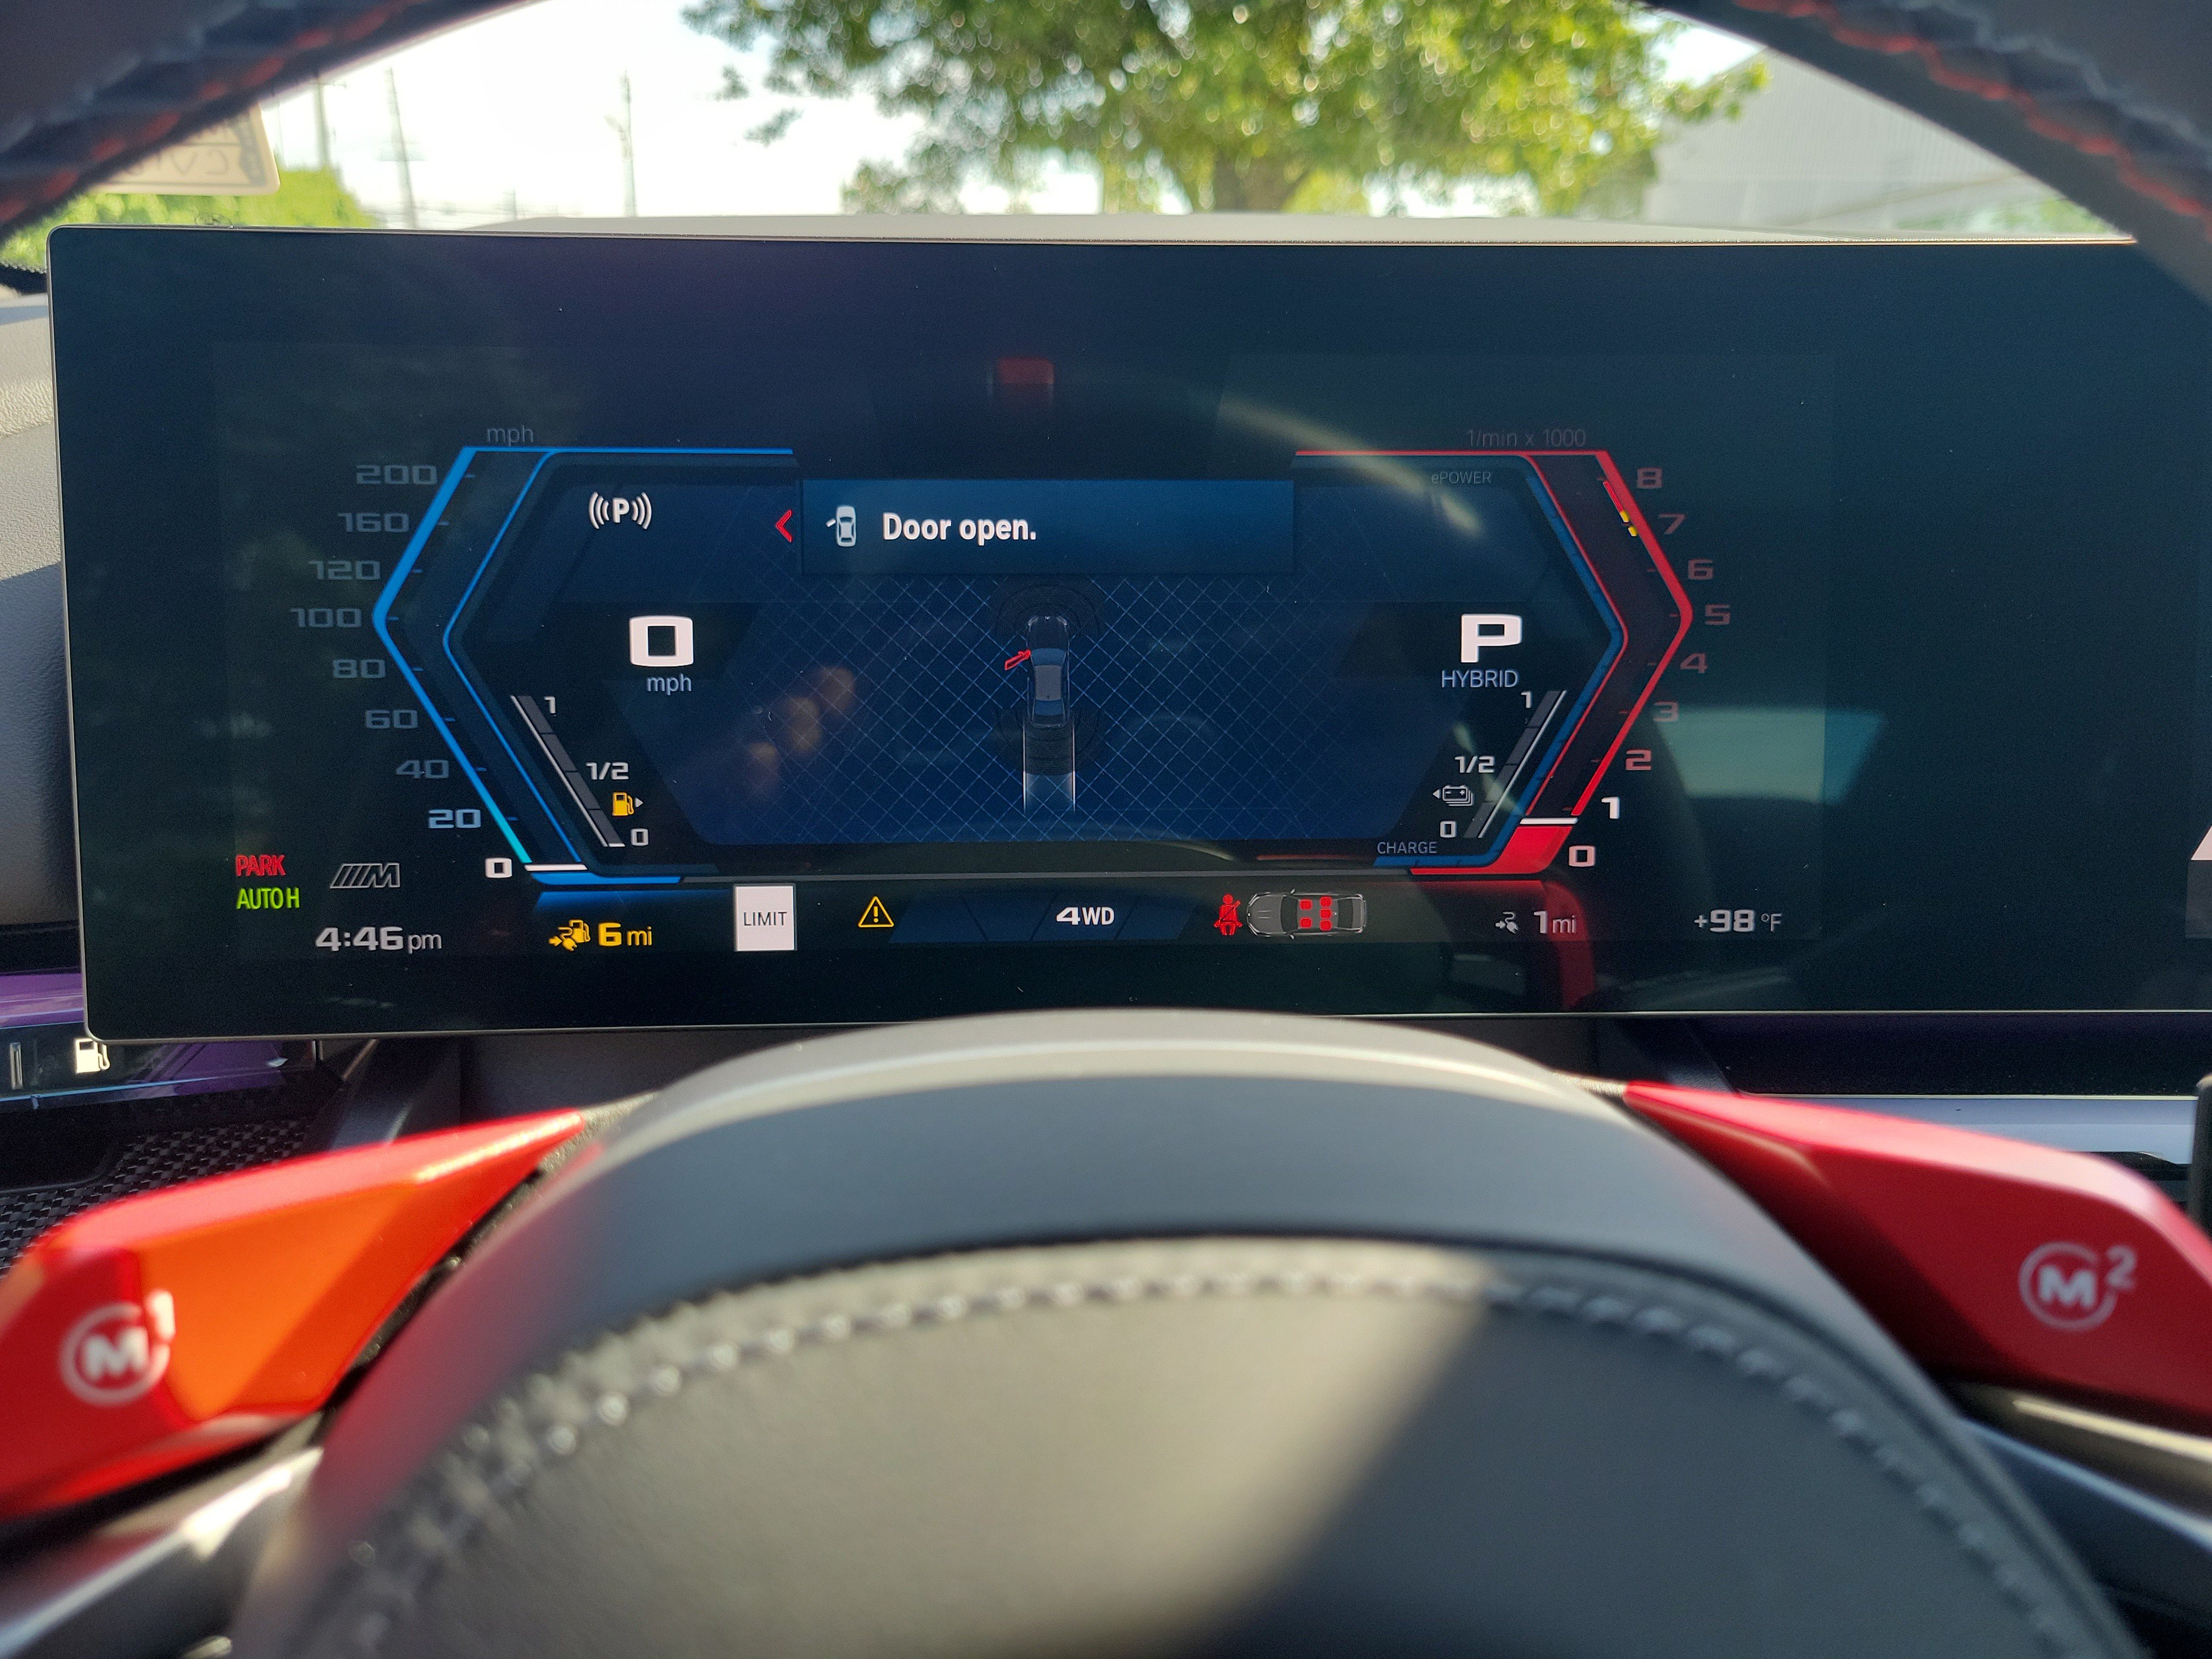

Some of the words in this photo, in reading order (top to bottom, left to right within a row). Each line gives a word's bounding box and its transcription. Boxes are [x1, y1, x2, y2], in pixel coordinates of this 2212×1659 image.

[487, 425, 534, 445] mph
[1467, 429, 1518, 447] 1/min
[1525, 434, 1534, 445] x
[1543, 428, 1587, 447] 1000
[357, 464, 438, 485] 200
[1431, 471, 1492, 484] ePOWER
[1637, 467, 1662, 489] 8
[338, 512, 409, 533] 160
[883, 512, 952, 540] Door
[959, 519, 1036, 546] open.
[1657, 514, 1685, 535] 7
[308, 559, 380, 580] 120
[1688, 558, 1713, 580] 6
[290, 607, 362, 628] 100
[1705, 604, 1731, 625] 5
[629, 615, 694, 667] 0
[332, 658, 386, 679] 80
[1680, 653, 1708, 674] 4
[647, 674, 692, 696] mph
[1441, 669, 1519, 688] HYBRID
[544, 696, 556, 715] 1
[1521, 691, 1532, 708] 1
[365, 709, 418, 729] 60
[1655, 701, 1680, 724] 3
[396, 759, 449, 779] 40
[586, 761, 629, 780] 1/2
[1455, 755, 1495, 774] 1/2
[1626, 749, 1652, 771] 2
[428, 808, 481, 829] 20
[1601, 797, 1620, 819] 1
[631, 828, 648, 847] 0
[1440, 820, 1457, 838] 0
[1376, 841, 1437, 855] CHARGE
[1568, 845, 1595, 867] 0
[235, 853, 286, 877] PARK
[485, 857, 512, 878] 0
[743, 911, 787, 927] LIMIT
[1056, 907, 1115, 925] 4WD
[1534, 911, 1548, 934] 1
[599, 922, 623, 946] 6
